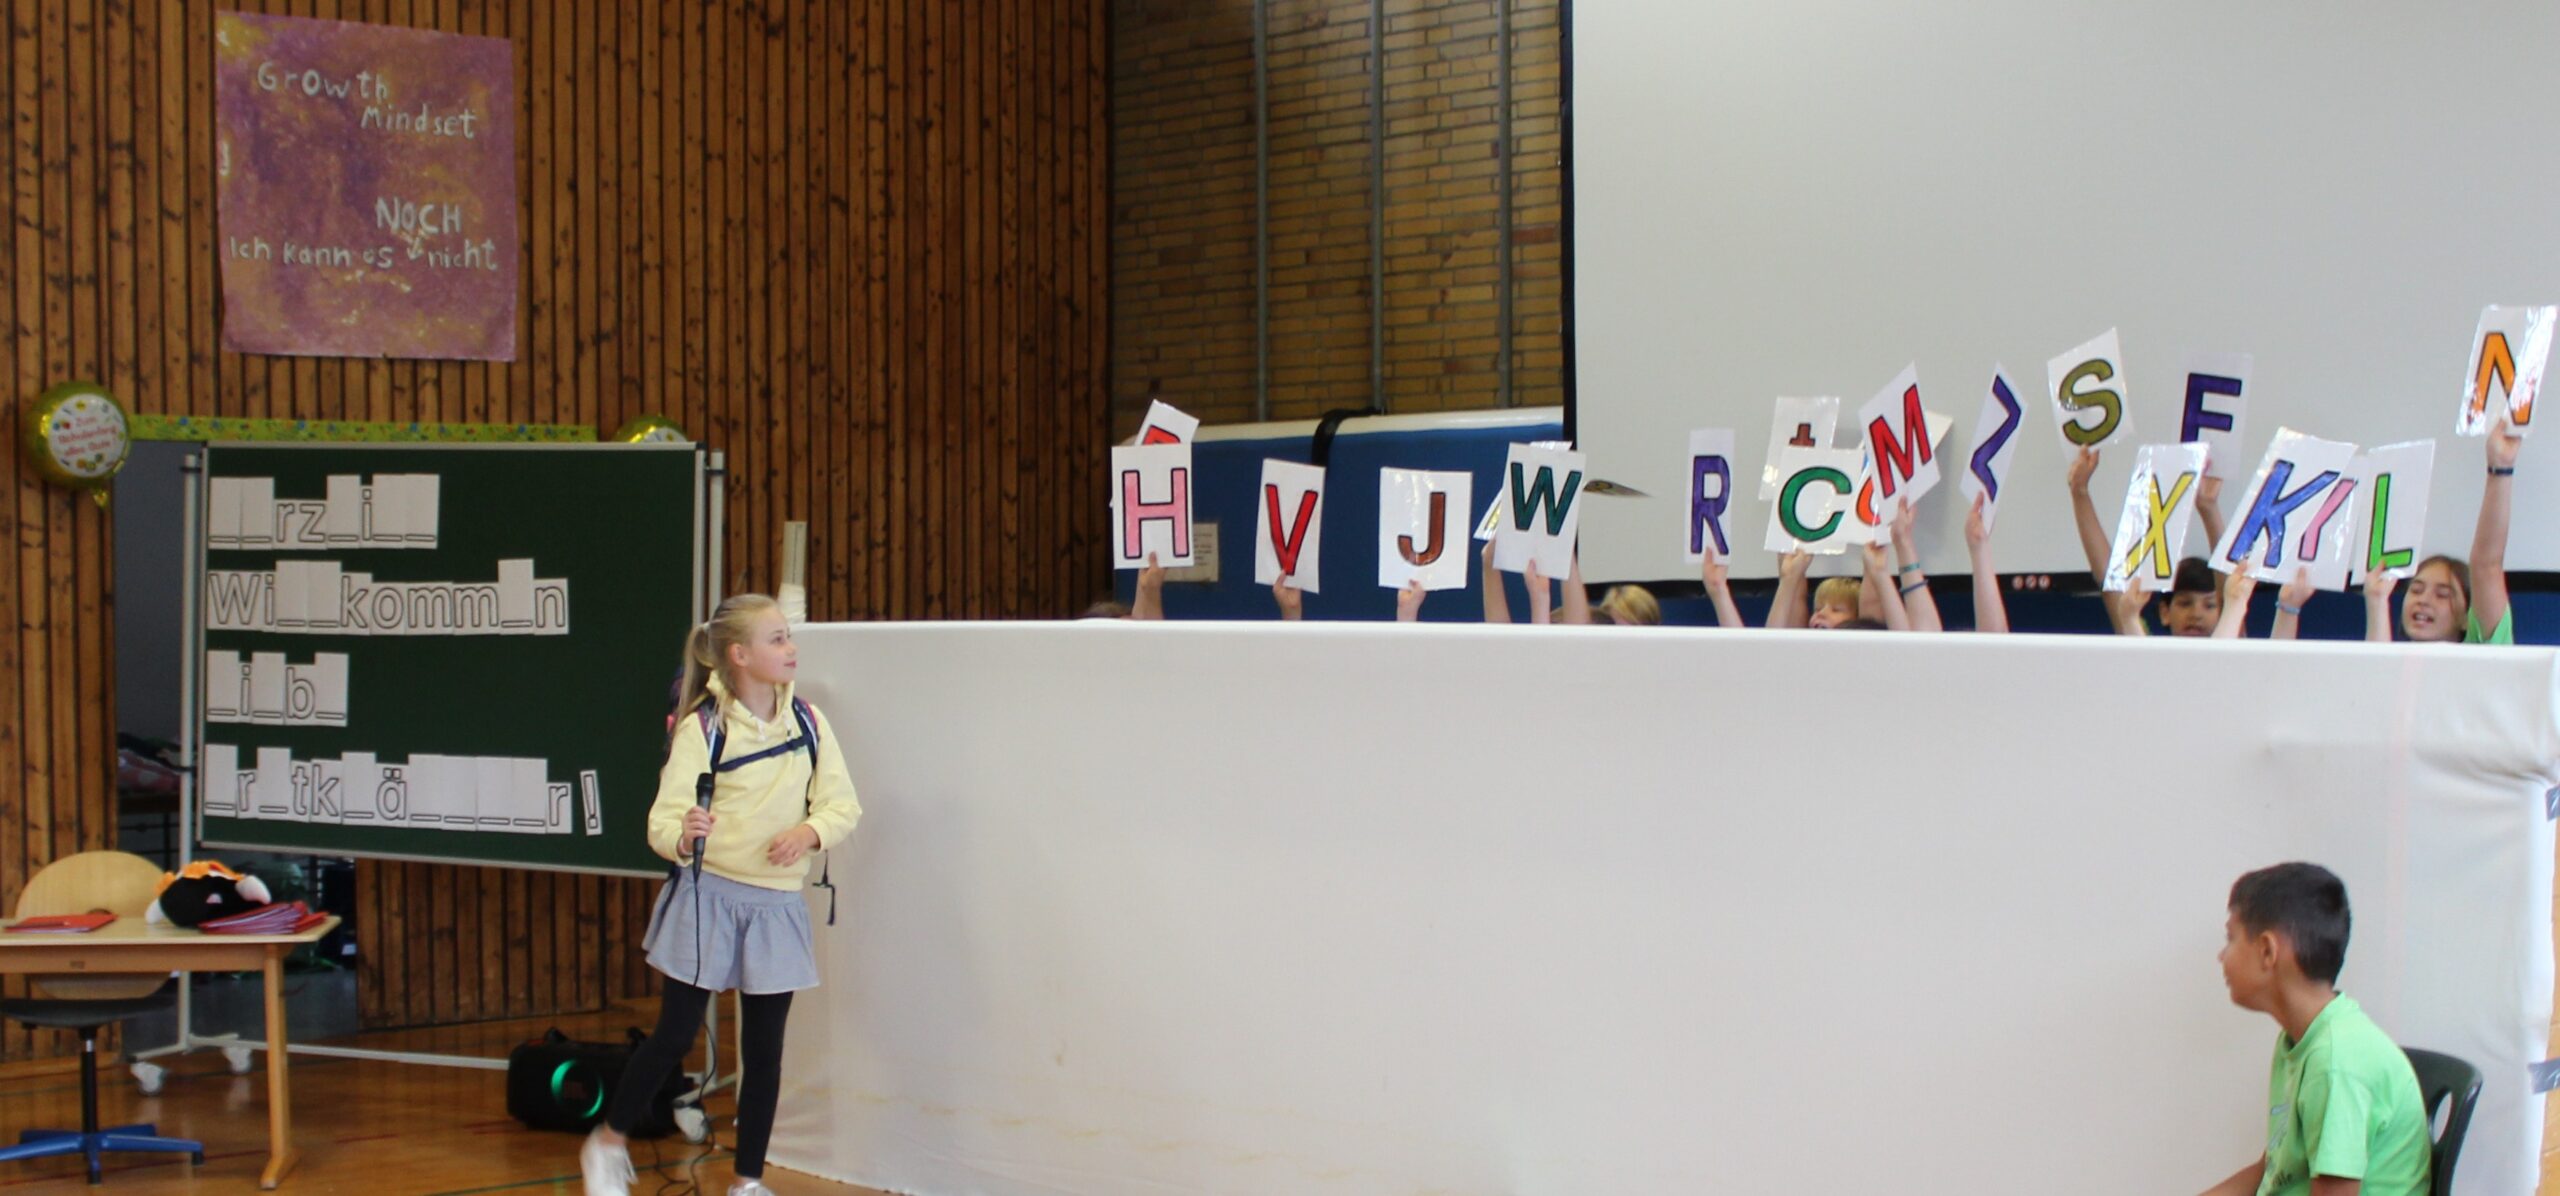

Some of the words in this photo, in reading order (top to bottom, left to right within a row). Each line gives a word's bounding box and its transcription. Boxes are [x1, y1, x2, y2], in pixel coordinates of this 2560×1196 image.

[257, 61, 390, 103] Growth
[360, 103, 477, 139] Mindset
[230, 236, 272, 261] Ich
[429, 238, 498, 271] nicht
[375, 196, 461, 234] NOCH
[2059, 358, 2122, 446] S
[2470, 332, 2536, 426] N
[1869, 383, 1932, 500] M
[1122, 467, 1190, 559] H
[1265, 483, 1319, 576] V
[1397, 491, 1447, 566] J
[1511, 462, 1582, 537] W
[1690, 454, 1731, 556] R
[1778, 466, 1852, 543] C
[2125, 471, 2196, 579] X
[2226, 459, 2341, 568] K
[2367, 473, 2413, 572] L
